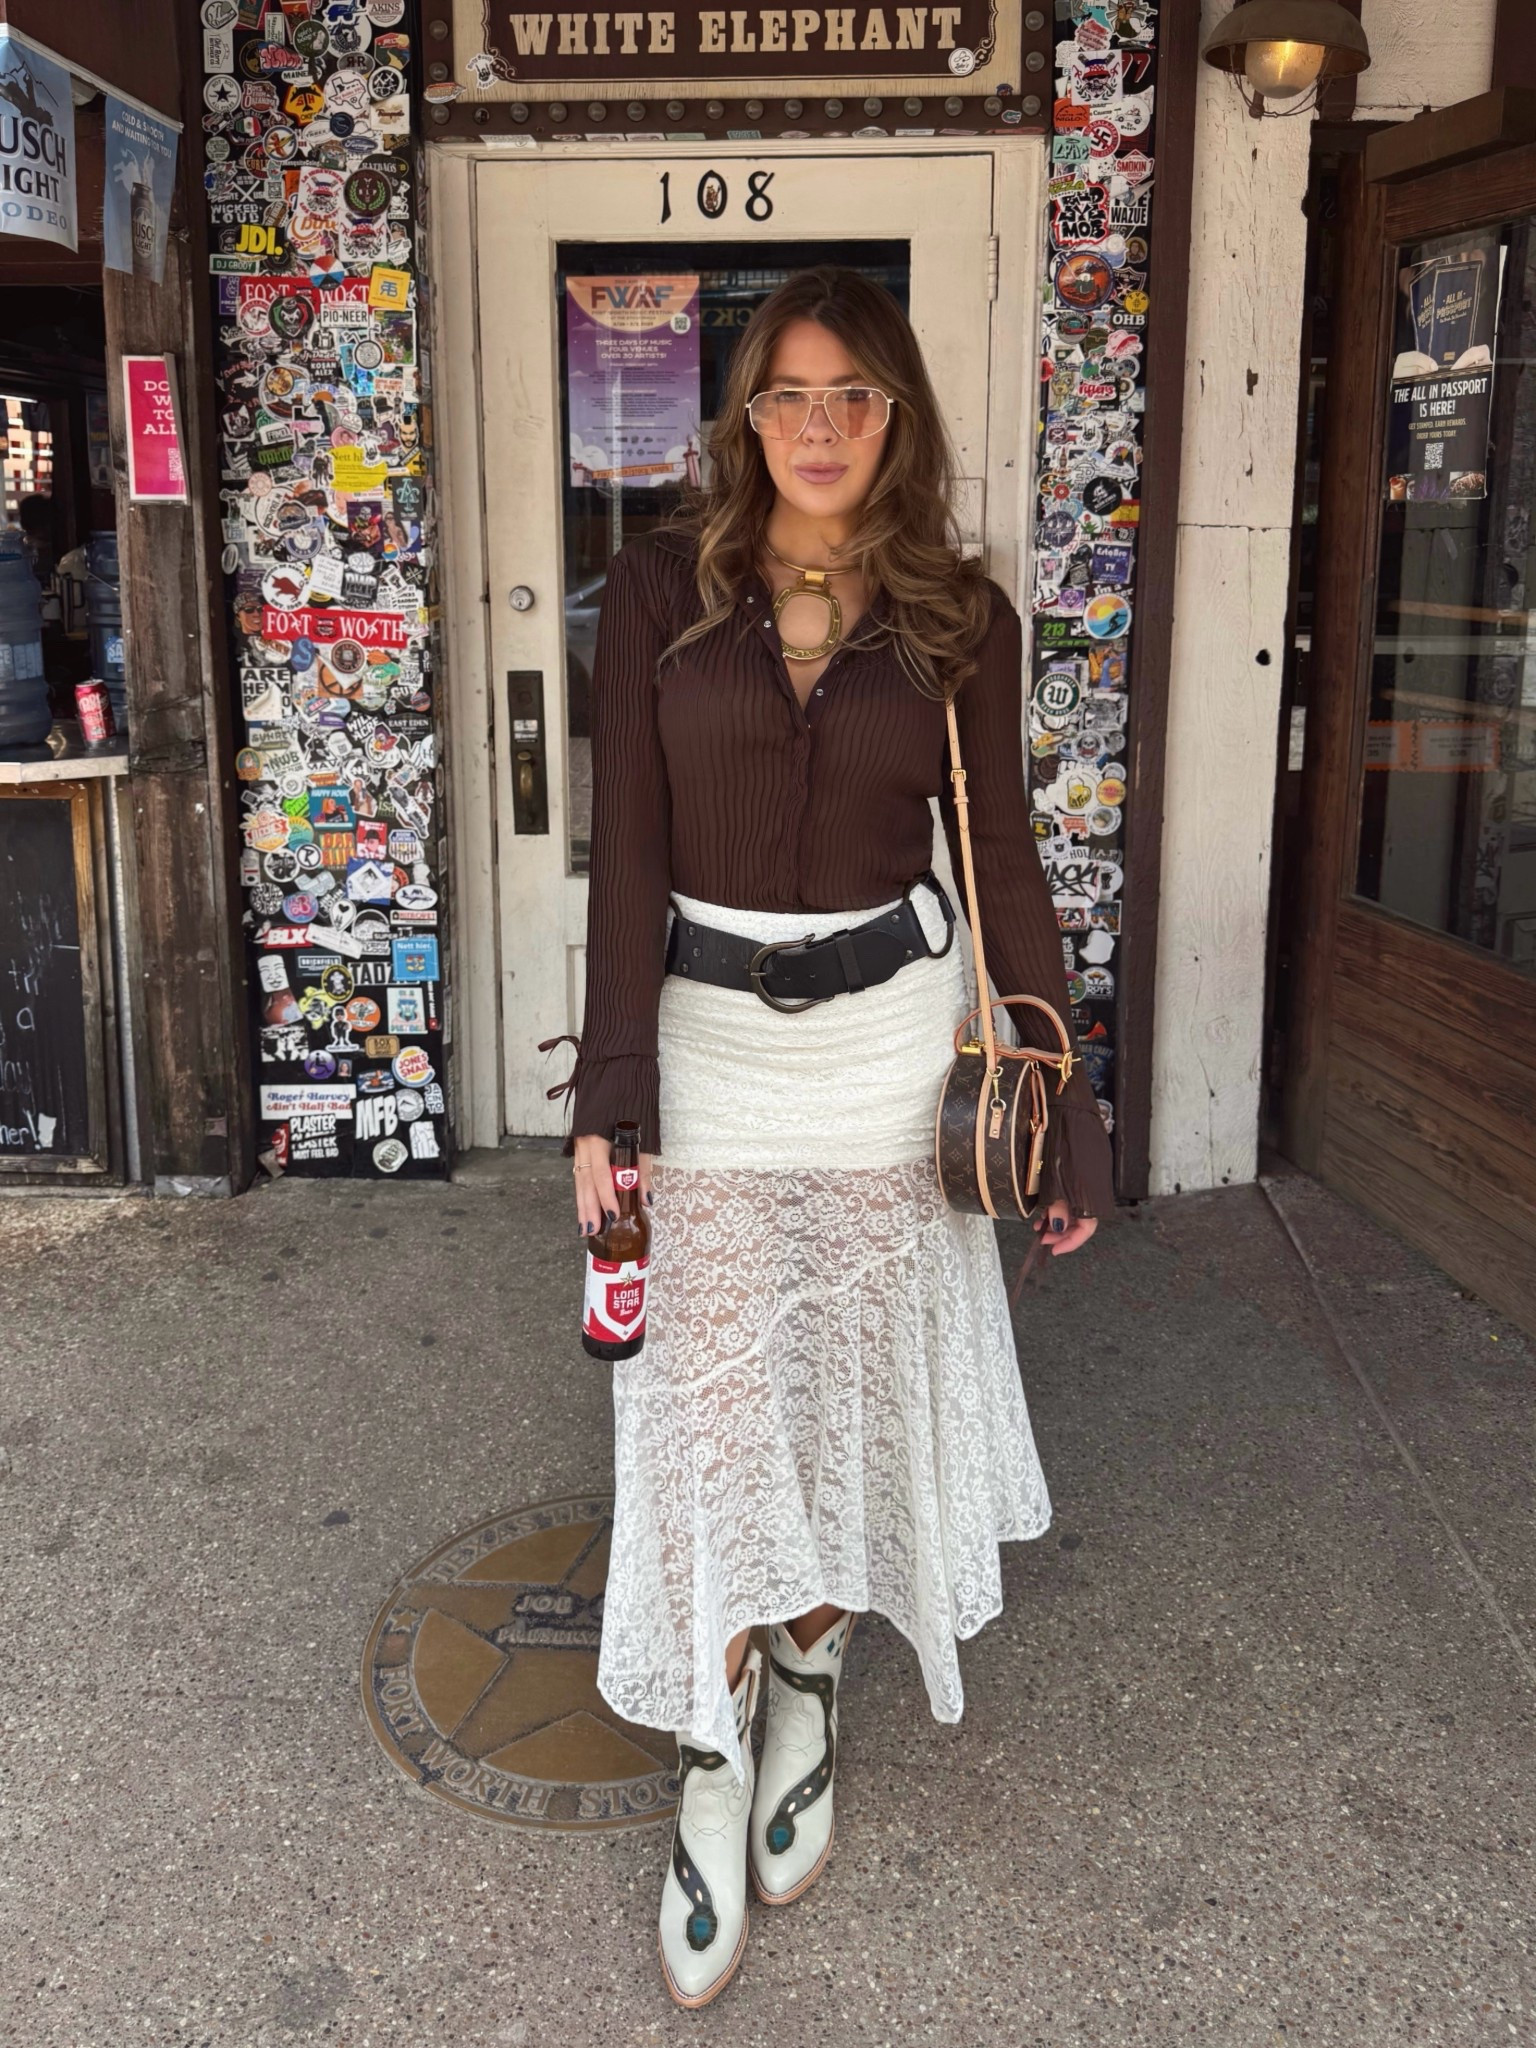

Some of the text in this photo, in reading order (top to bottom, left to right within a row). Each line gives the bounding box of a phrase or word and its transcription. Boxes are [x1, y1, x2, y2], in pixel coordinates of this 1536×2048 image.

[371, 3, 400, 12] AKINS
[509, 8, 961, 55] WHITE ELEPHANT
[112, 120, 124, 134] AND
[122, 111, 165, 142] COLD & SOOTH
[1116, 161, 1147, 172] SMOKIN
[660, 170, 775, 224] 108
[211, 204, 258, 213] WICKED
[211, 213, 259, 223] LOUD
[1062, 220, 1105, 238] MOB
[236, 224, 283, 255] JDI.
[216, 261, 227, 269] DJ
[320, 284, 370, 302] WORT
[323, 311, 368, 322] PIO-NEER
[1112, 314, 1145, 326] OHB
[1394, 378, 1487, 403] THE ALL IN PASSPORT
[1419, 400, 1456, 417] IS HERE!
[1042, 623, 1067, 636] 213
[243, 670, 291, 681] ARE
[388, 719, 429, 727] EAST EDEN
[416, 942, 432, 950] hier.
[398, 1052, 428, 1068] JONES
[400, 1062, 431, 1078] SNAIL
[268, 1091, 351, 1102] Roger Harvey
[267, 1102, 352, 1112] Ain't Half Bad
[290, 1116, 336, 1133] PLASTER
[356, 1095, 398, 1141] MFB
[311, 1147, 326, 1158] FEEL
[326, 1146, 339, 1158] BAD
[613, 1287, 640, 1300] LONE
[612, 1297, 640, 1309] STAR
[424, 1513, 540, 1585] TEXAS
[379, 1665, 426, 1742] FORT
[418, 1739, 551, 1816] WORTH
